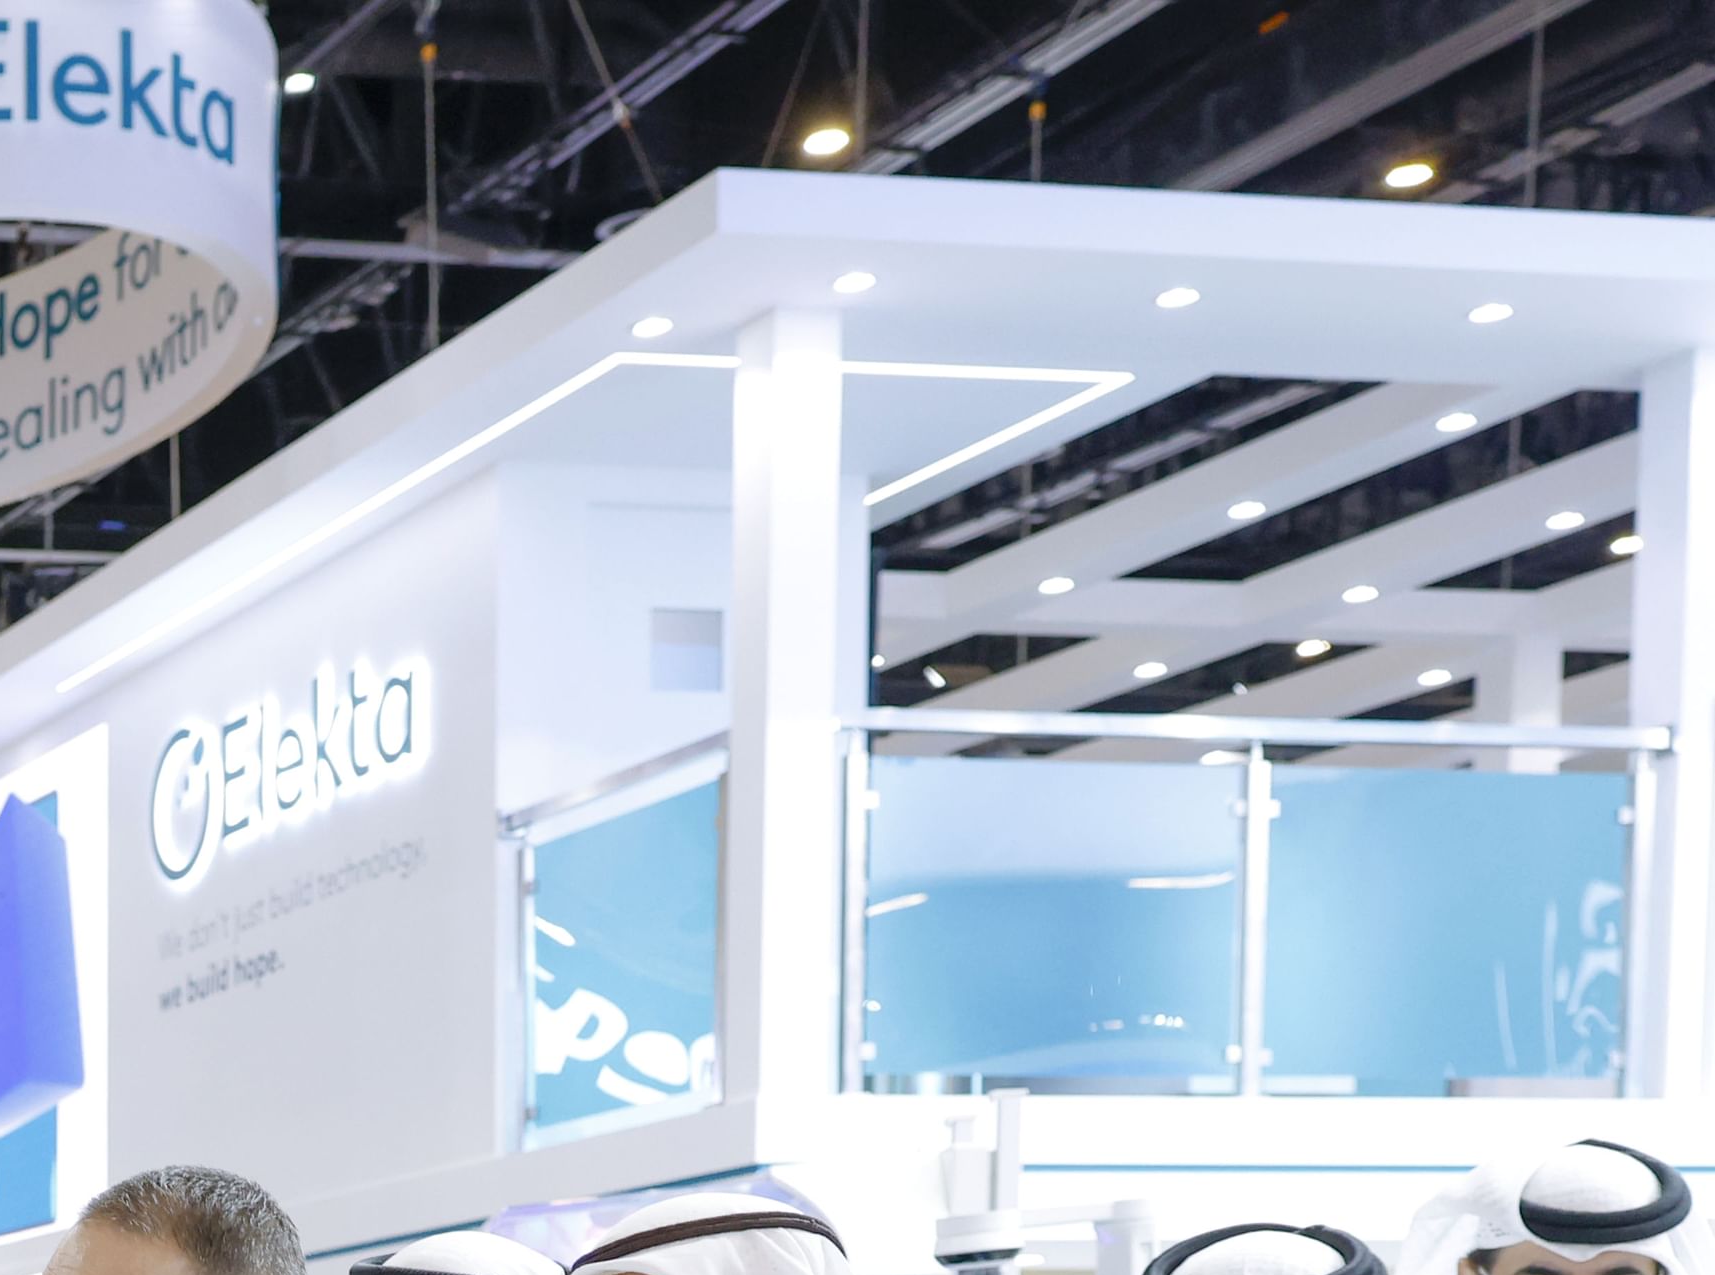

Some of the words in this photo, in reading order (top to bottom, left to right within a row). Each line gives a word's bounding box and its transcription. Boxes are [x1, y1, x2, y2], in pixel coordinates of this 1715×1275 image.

[138, 289, 209, 392] with
[222, 669, 414, 839] Elekta
[186, 964, 229, 1003] build
[233, 950, 285, 989] hope.
